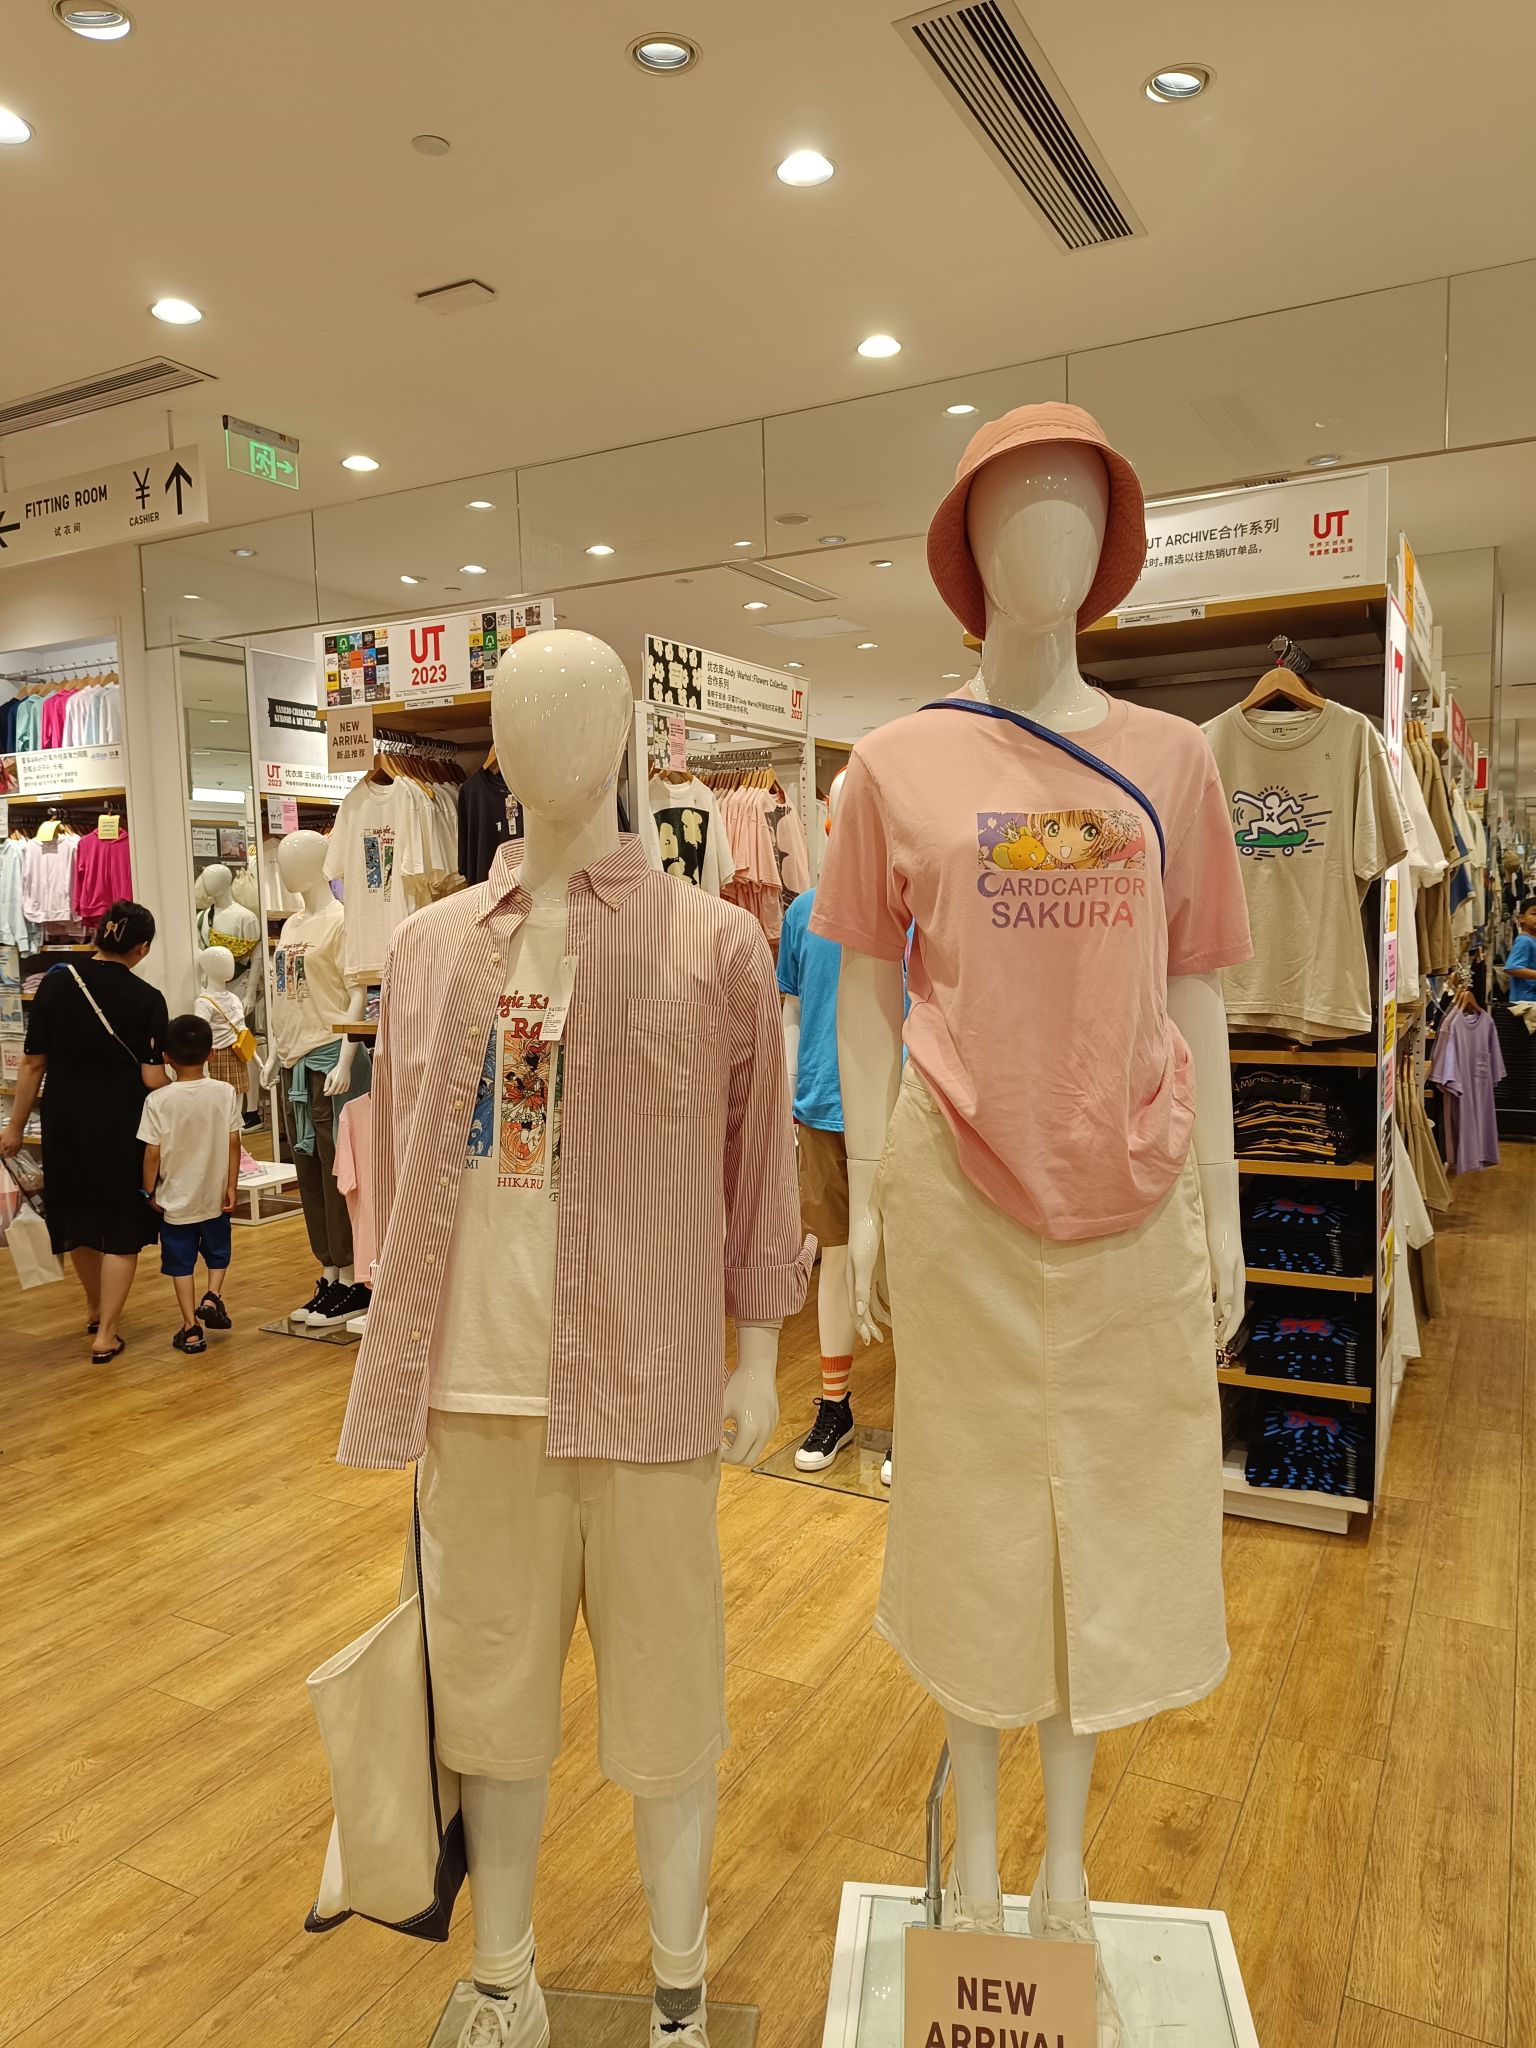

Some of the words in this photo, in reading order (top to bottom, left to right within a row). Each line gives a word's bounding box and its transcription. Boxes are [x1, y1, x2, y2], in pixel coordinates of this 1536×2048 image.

[25, 494, 70, 519] FITTING
[75, 484, 108, 508] ROOM
[129, 511, 160, 527] CASHIER
[1313, 509, 1350, 539] UT
[54, 522, 81, 537] 试衣间
[1146, 536, 1162, 550] UT
[1165, 517, 1280, 547] ARCHIVE合作系列
[409, 624, 447, 664] UT
[411, 664, 447, 686] 2023
[791, 689, 804, 710] UT
[791, 709, 803, 721] 2023
[340, 720, 360, 733] NEW
[332, 734, 370, 747] ARRIVAL
[336, 748, 366, 760] 新品推荐
[266, 764, 281, 779] UT
[268, 778, 282, 787] 2023
[976, 872, 1146, 898] CARDCAPTOR
[991, 900, 1134, 928] SAKURA
[497, 1176, 544, 1190] HIKARU
[957, 1975, 1037, 2017] NEW
